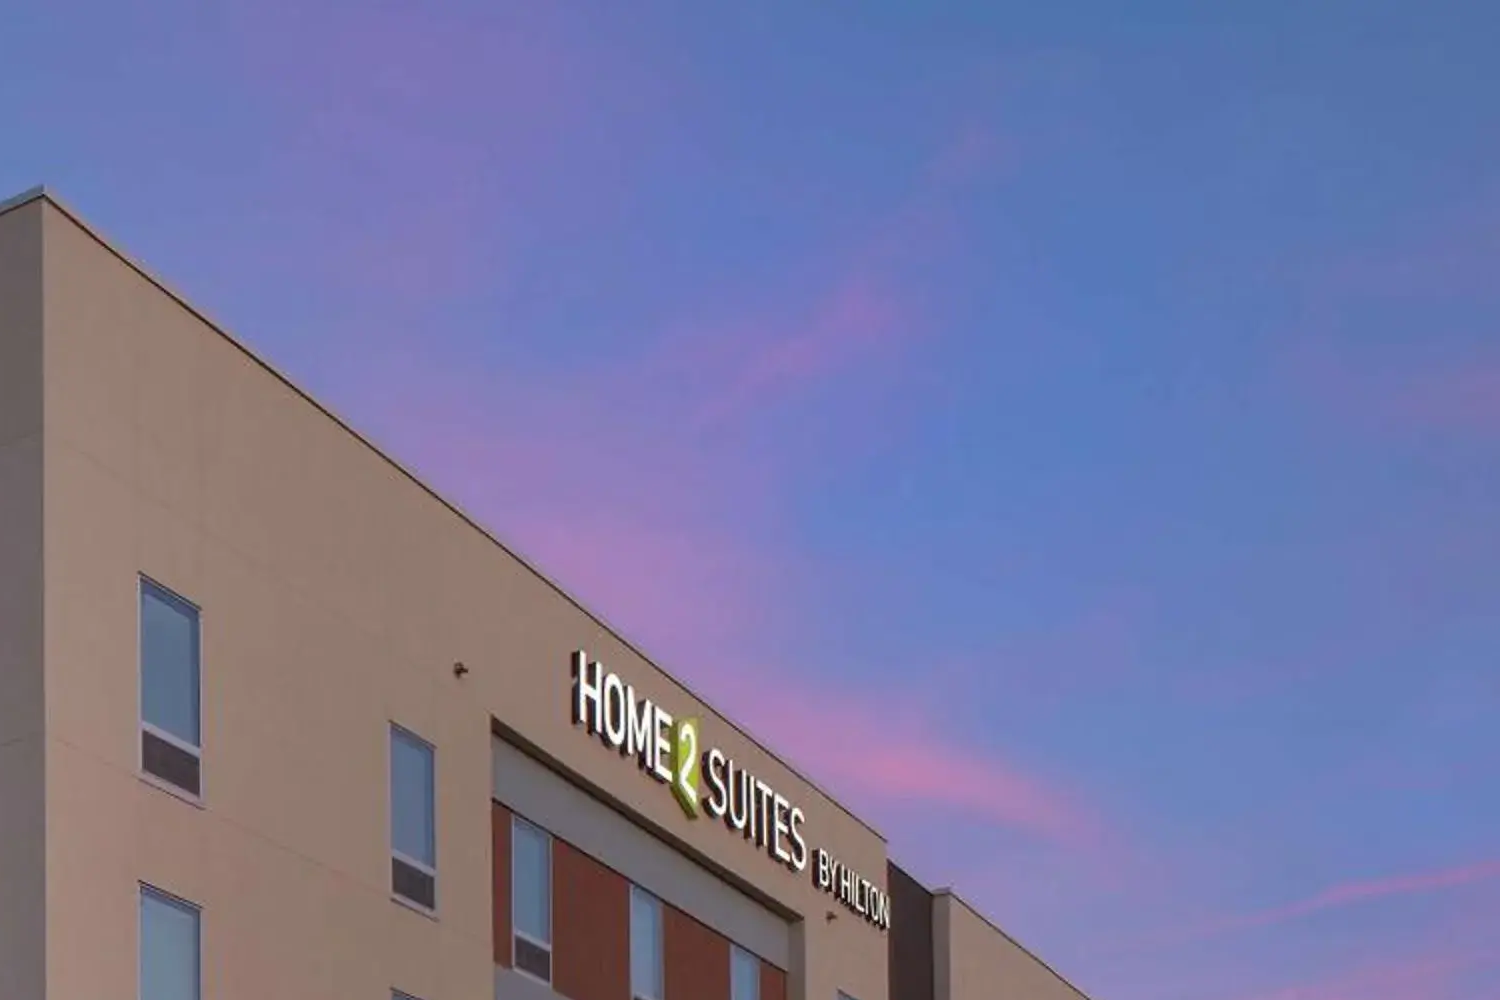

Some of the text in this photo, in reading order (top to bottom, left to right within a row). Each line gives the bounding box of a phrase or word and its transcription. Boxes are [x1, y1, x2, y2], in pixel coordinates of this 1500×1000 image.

[705, 748, 807, 871] SUITES
[818, 847, 839, 893] BY
[841, 864, 891, 929] HILTON
